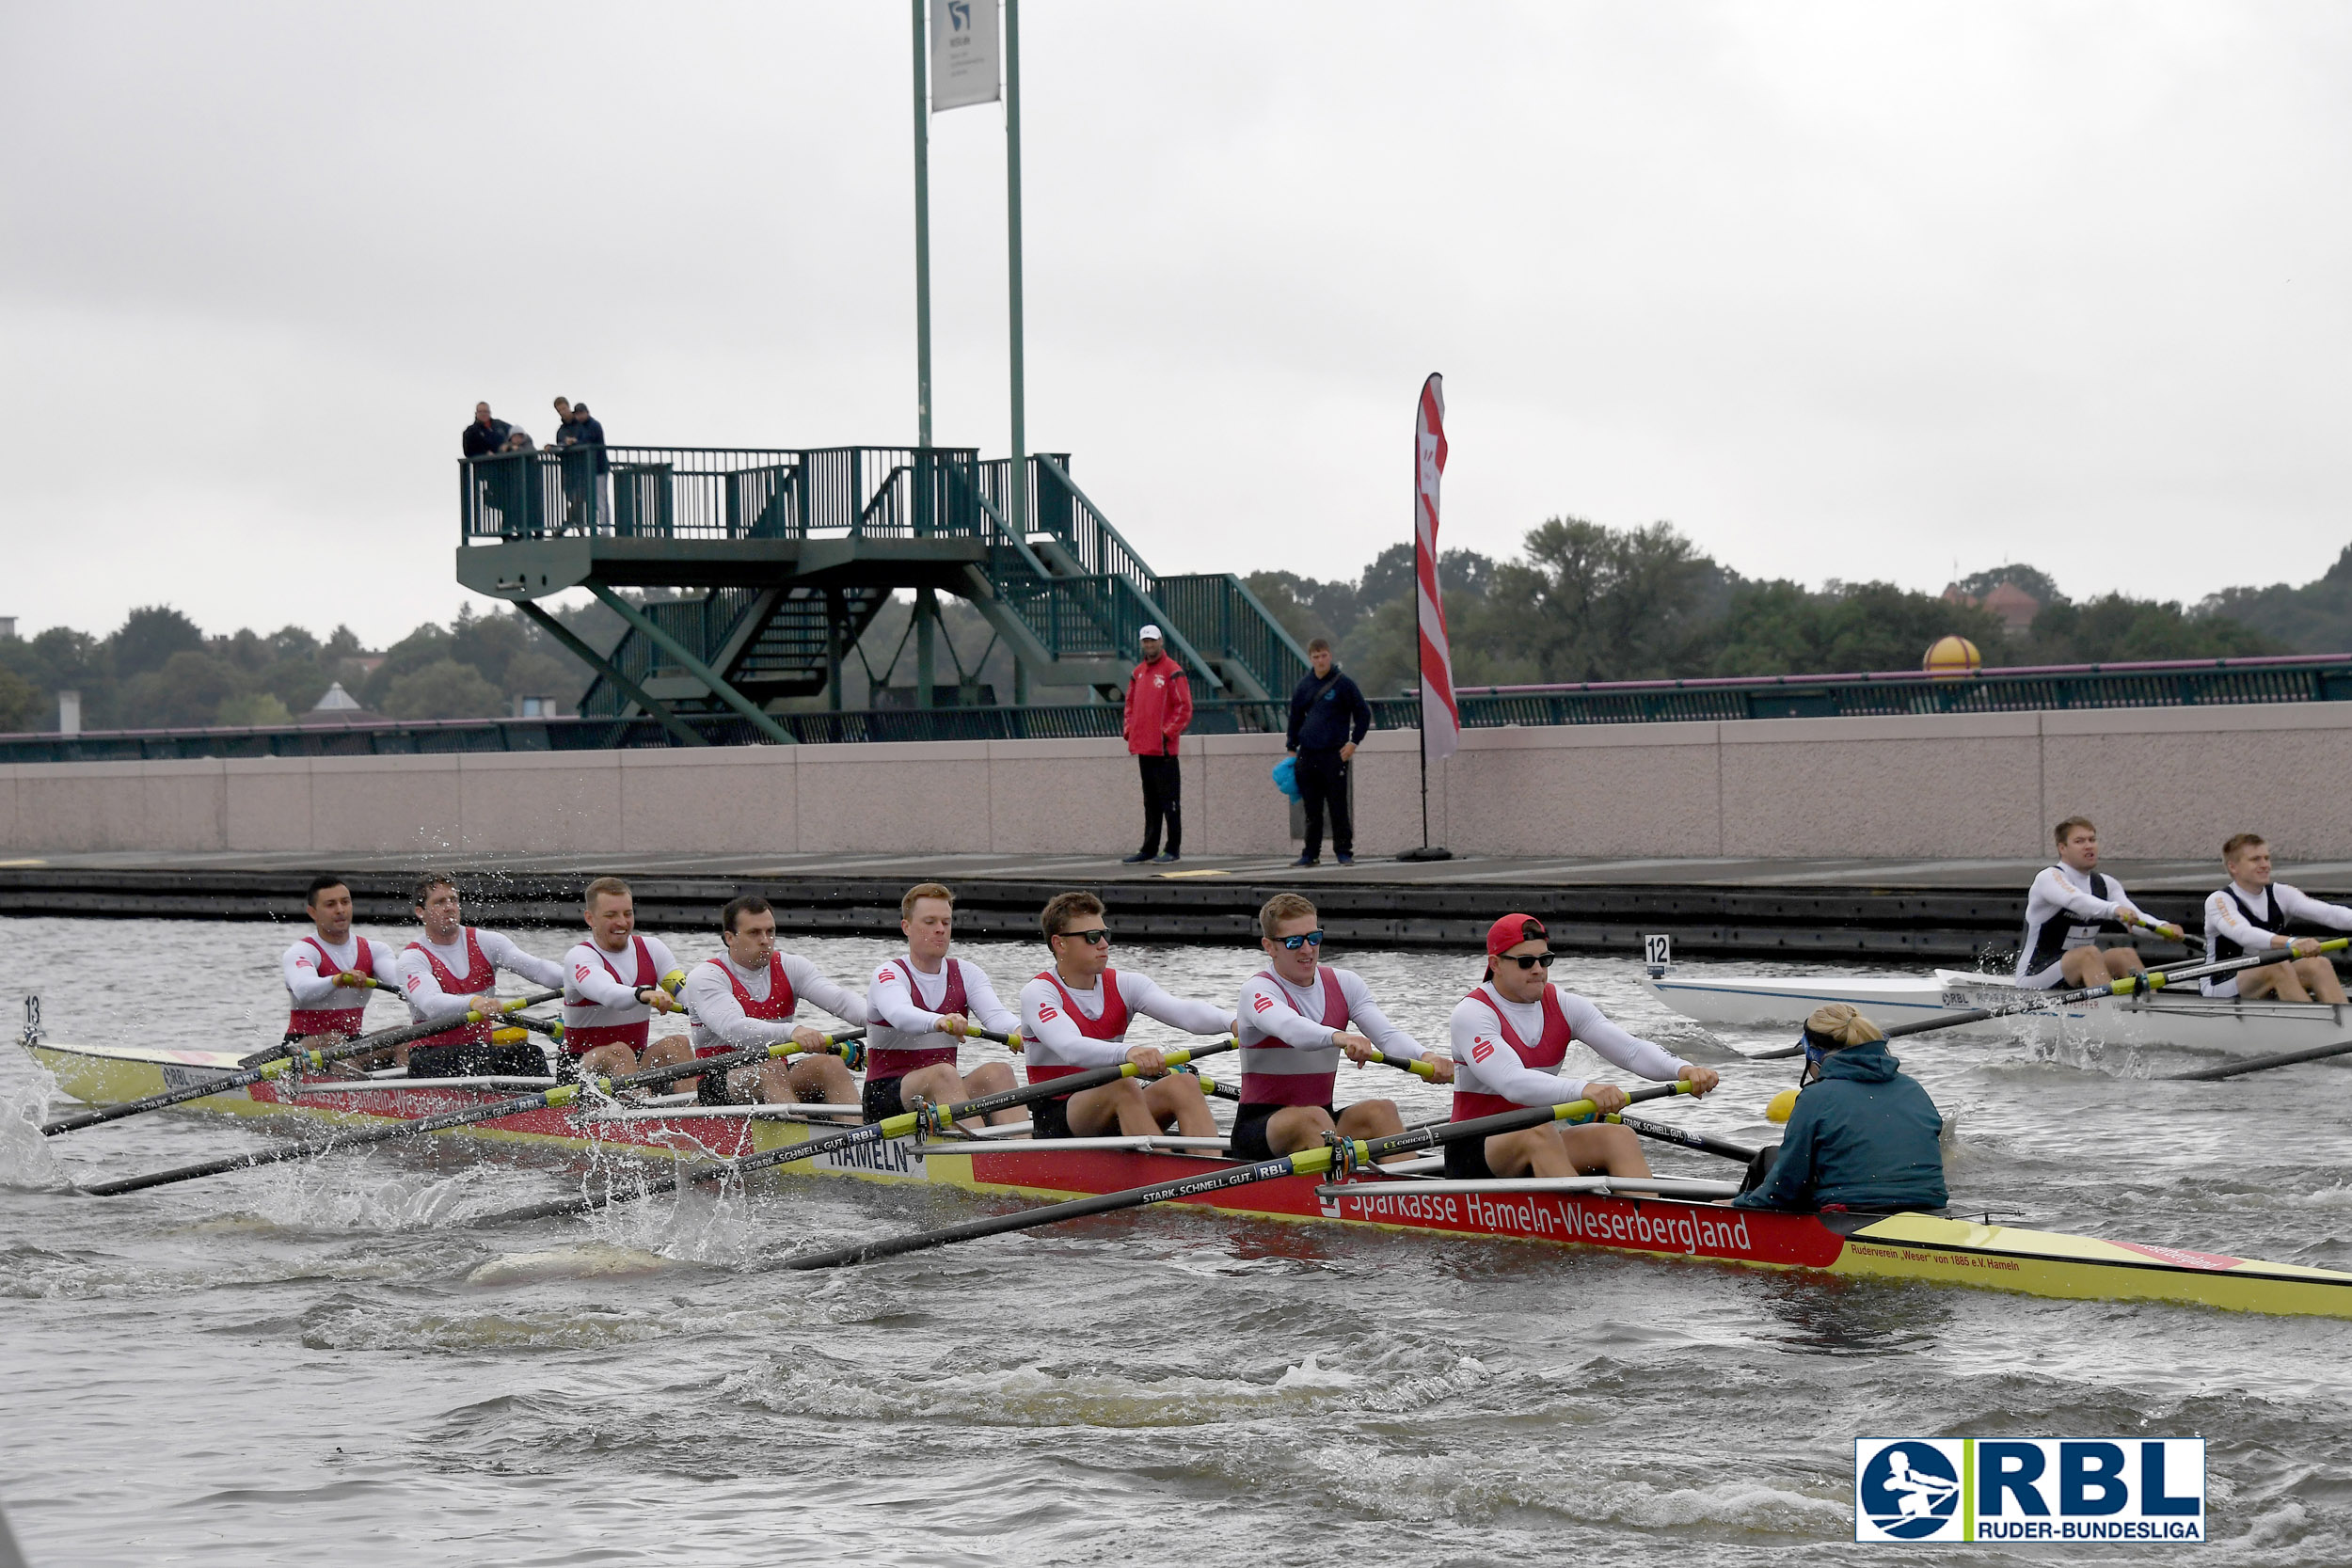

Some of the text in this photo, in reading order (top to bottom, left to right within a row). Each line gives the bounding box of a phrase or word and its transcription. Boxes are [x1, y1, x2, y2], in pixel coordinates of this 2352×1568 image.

[1648, 937, 1668, 963] 12
[1950, 993, 1969, 1005] RBL
[2087, 987, 2107, 998] RBL
[25, 995, 40, 1025] 13
[170, 1068, 191, 1086] RBL
[234, 1071, 260, 1086] RBL
[518, 1098, 543, 1111] RBL
[851, 1129, 877, 1142] RBL
[1643, 1122, 1670, 1136] SCHNELL.
[1687, 1132, 1702, 1142] RBL
[829, 1137, 909, 1173] HAMELN
[1143, 1164, 1287, 1203] STARK. SCHNELL. GUT. RBL
[1349, 1178, 1752, 1255] Sparkasse Hameln-Weserbergland
[1851, 1243, 1899, 1259] Ruderverein
[1933, 1255, 1949, 1265] von
[1950, 1256, 1970, 1267] 1885
[1971, 1258, 1986, 1269] e.V.
[1987, 1259, 2020, 1272] Hameln
